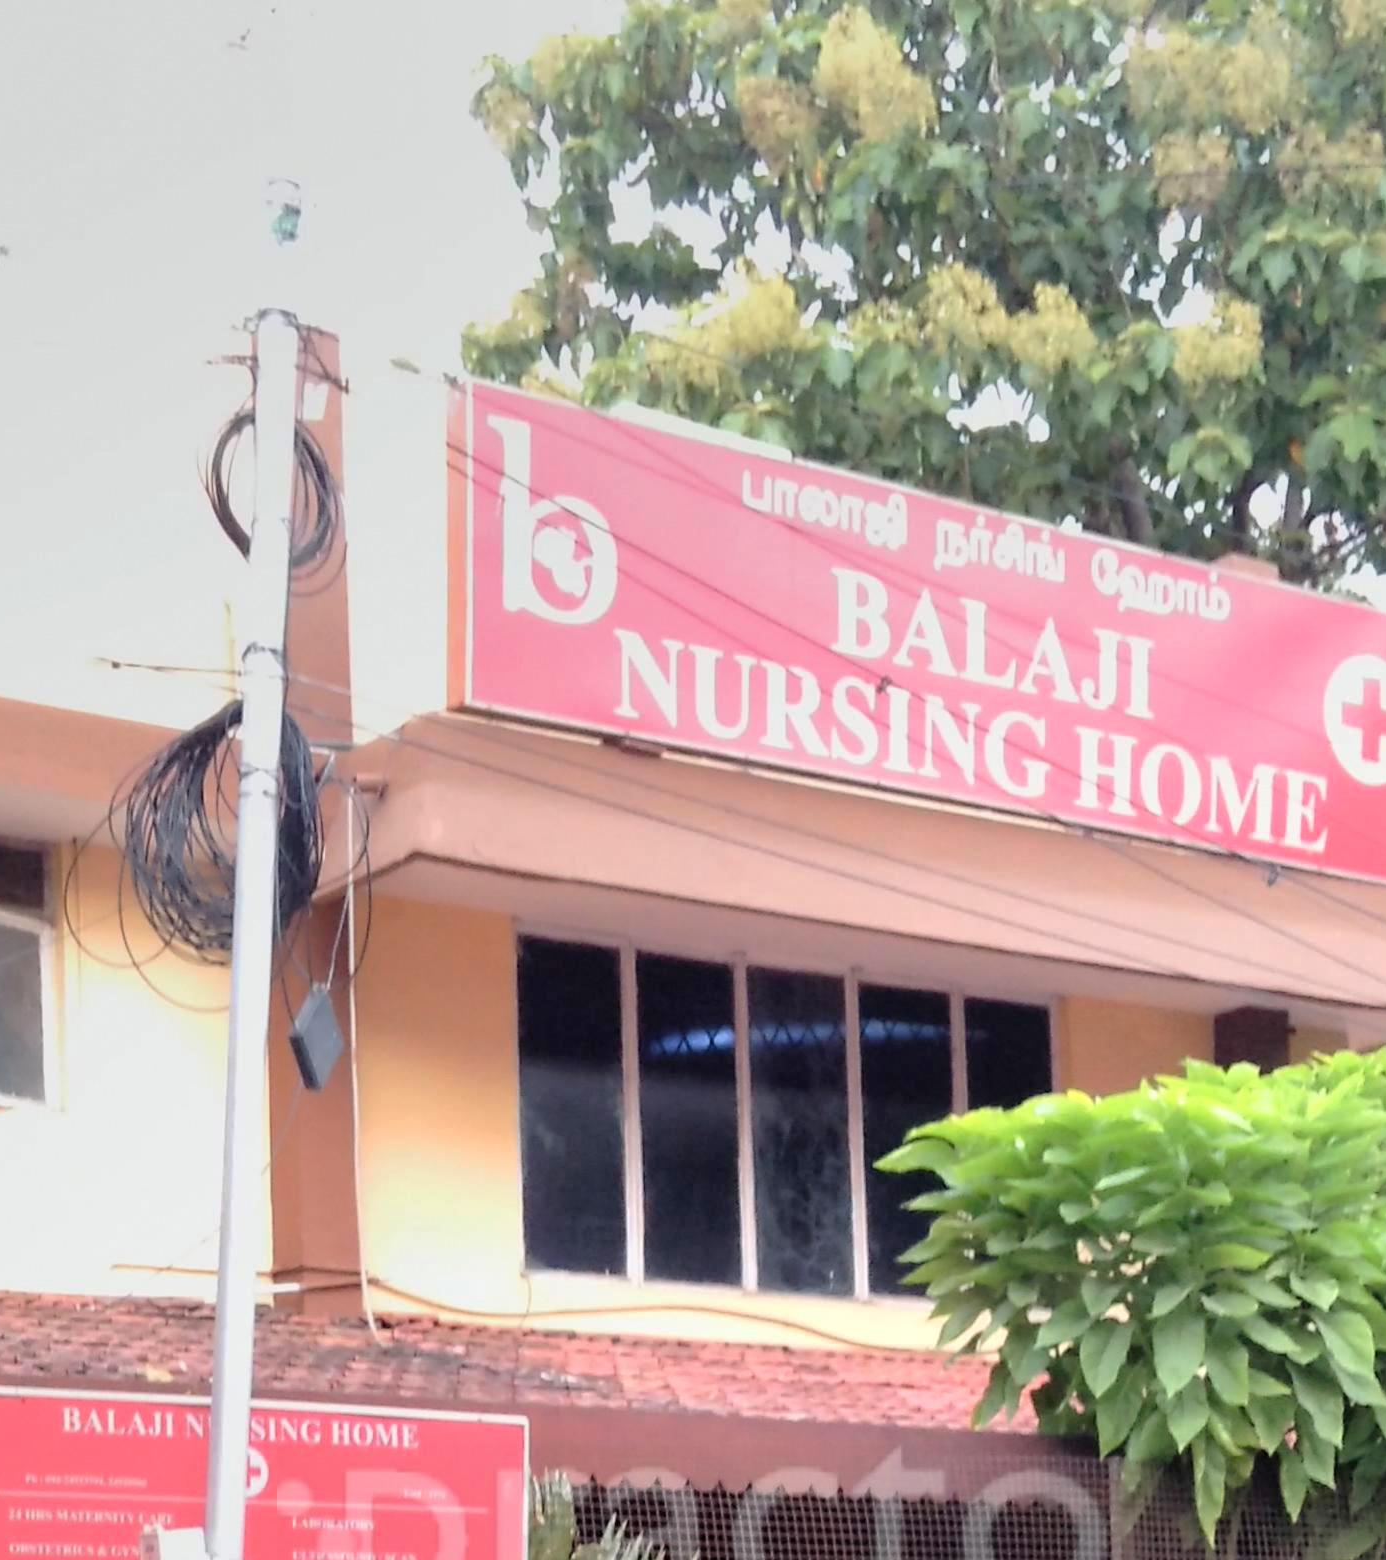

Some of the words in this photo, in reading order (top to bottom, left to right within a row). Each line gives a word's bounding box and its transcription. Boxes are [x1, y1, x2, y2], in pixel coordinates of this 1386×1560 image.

[741, 470, 907, 548] பாலாஜி
[934, 515, 1065, 582] நர்சிங்
[1091, 545, 1231, 621] ஹோம்
[830, 567, 1154, 719] BALAJI
[614, 629, 1050, 798] NURSING
[1074, 726, 1328, 853] HOME
[63, 1406, 174, 1438] BALAJI
[184, 1413, 322, 1445] NSING
[331, 1420, 419, 1449] HOME
